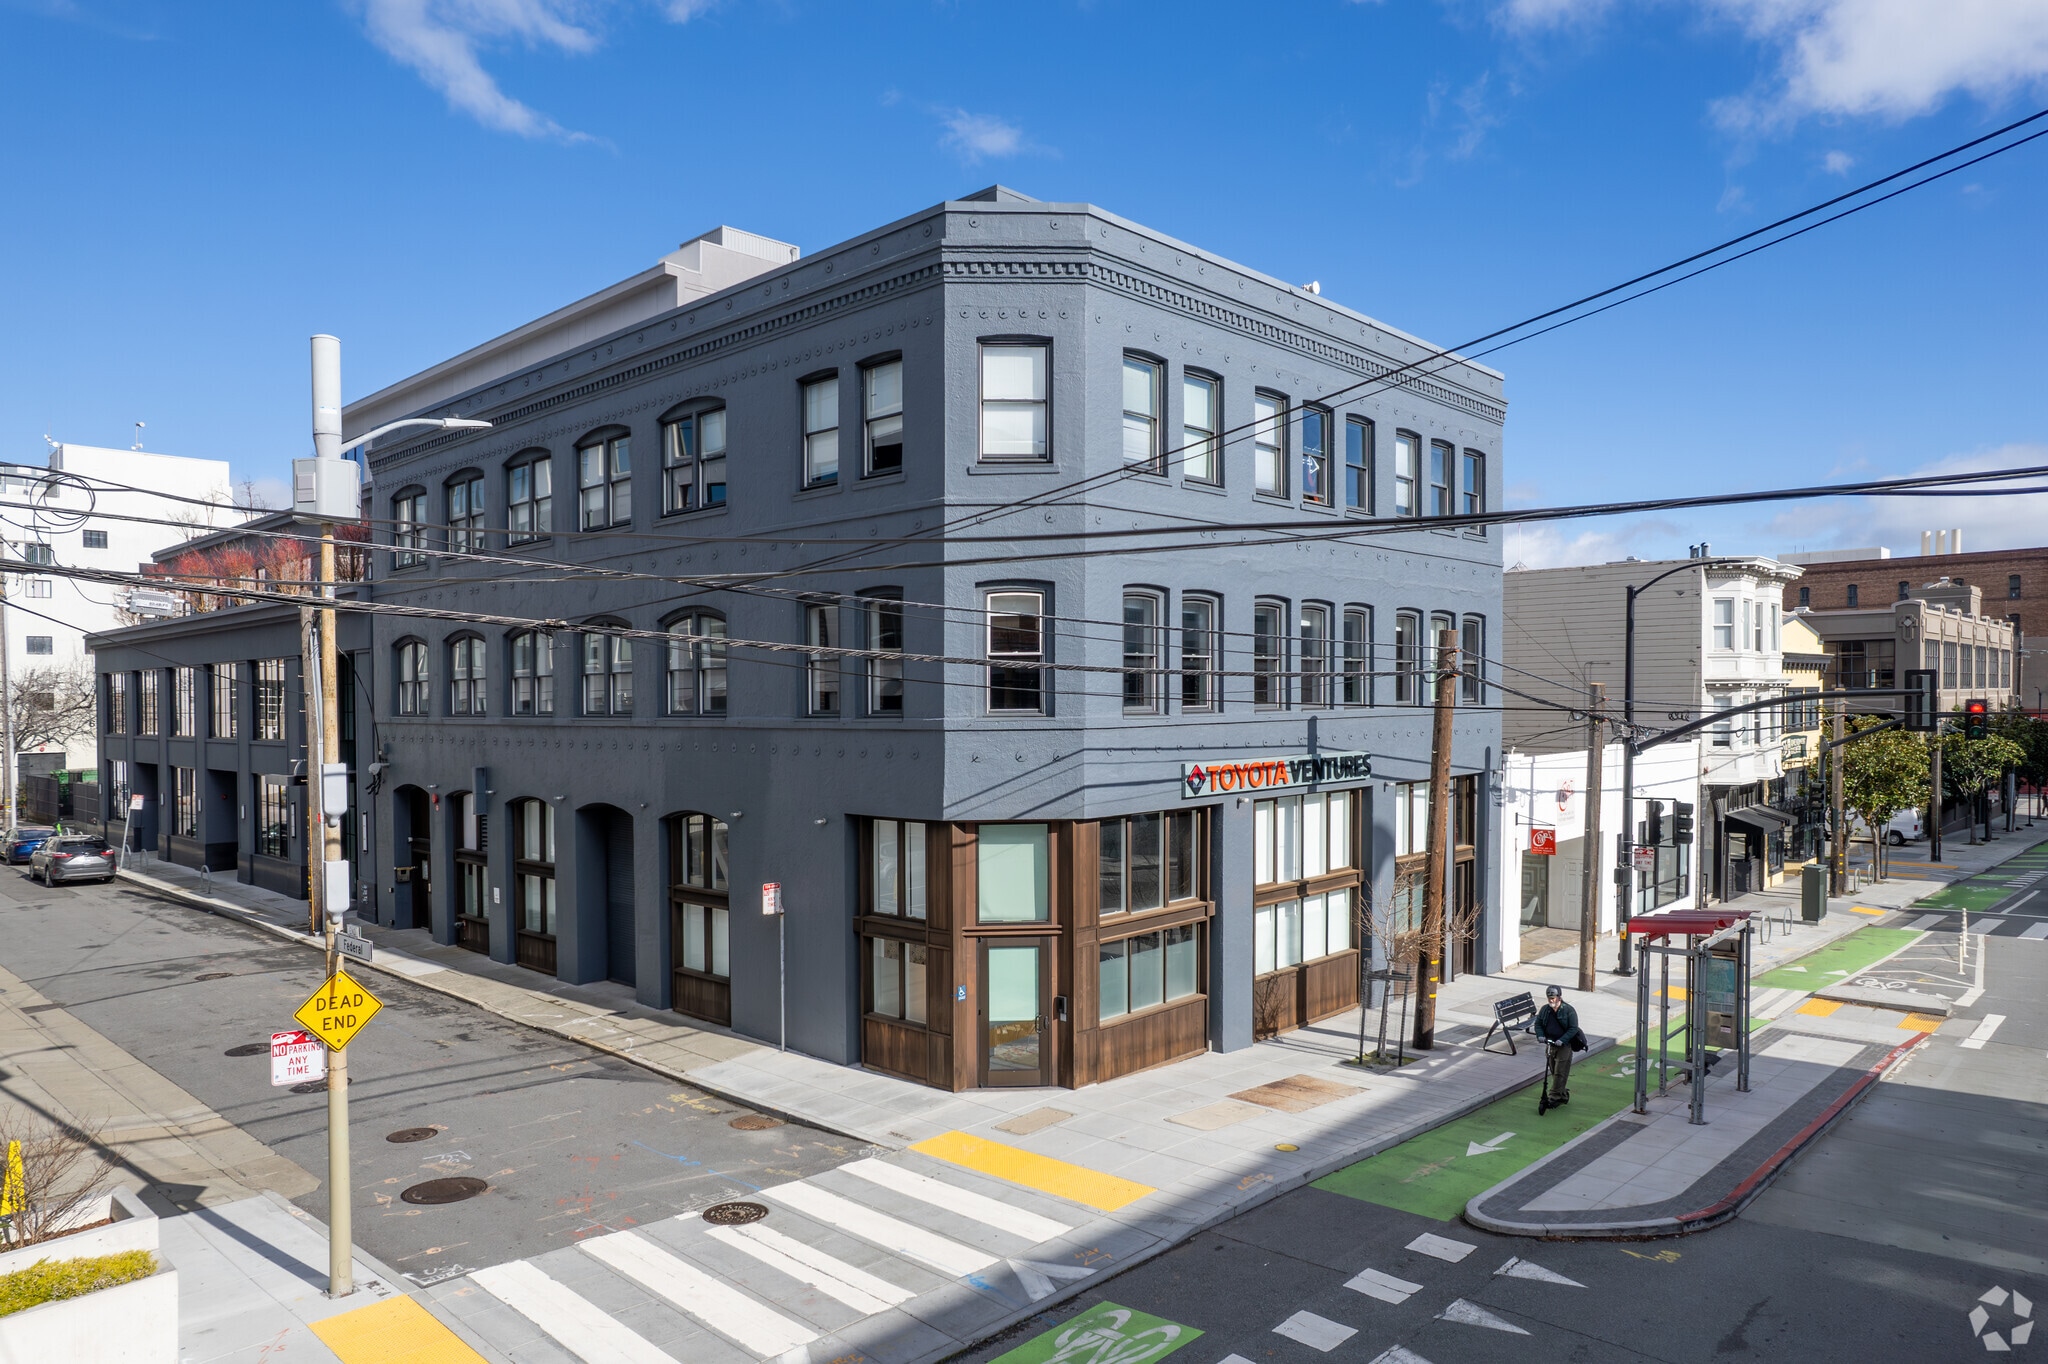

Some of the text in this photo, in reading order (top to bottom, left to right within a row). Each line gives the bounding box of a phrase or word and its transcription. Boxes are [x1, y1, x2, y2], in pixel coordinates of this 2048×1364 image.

[1206, 754, 1372, 792] TOYOTA VENTURES
[343, 938, 363, 955] Federal
[316, 993, 364, 1012] DEAD
[322, 1014, 357, 1031] END
[273, 1045, 287, 1057] NO
[288, 1056, 308, 1066] ANY
[287, 1065, 309, 1076] TIME
